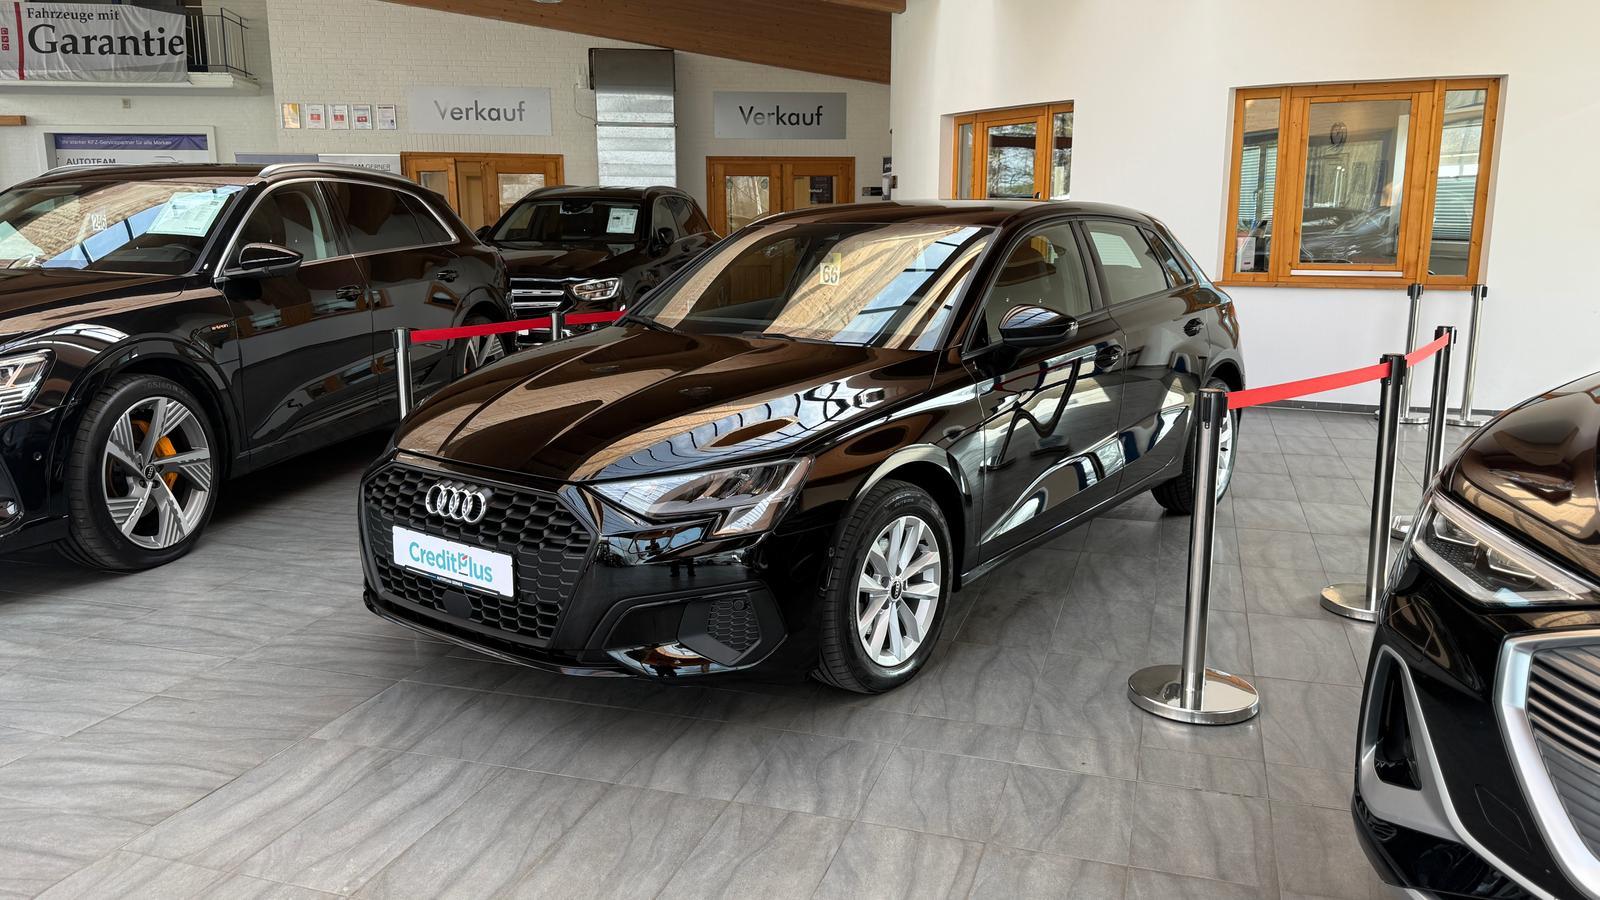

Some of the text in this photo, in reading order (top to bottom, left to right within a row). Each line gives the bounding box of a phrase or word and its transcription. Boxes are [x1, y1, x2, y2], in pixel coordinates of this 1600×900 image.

[27, 8, 120, 23] Fahrzeuge mit
[28, 23, 184, 56] Garantie
[433, 99, 526, 121] Verkauf
[738, 105, 823, 126] Verkauf
[66, 157, 116, 166] AUTOTEAM
[409, 541, 493, 583] CreditPlus
